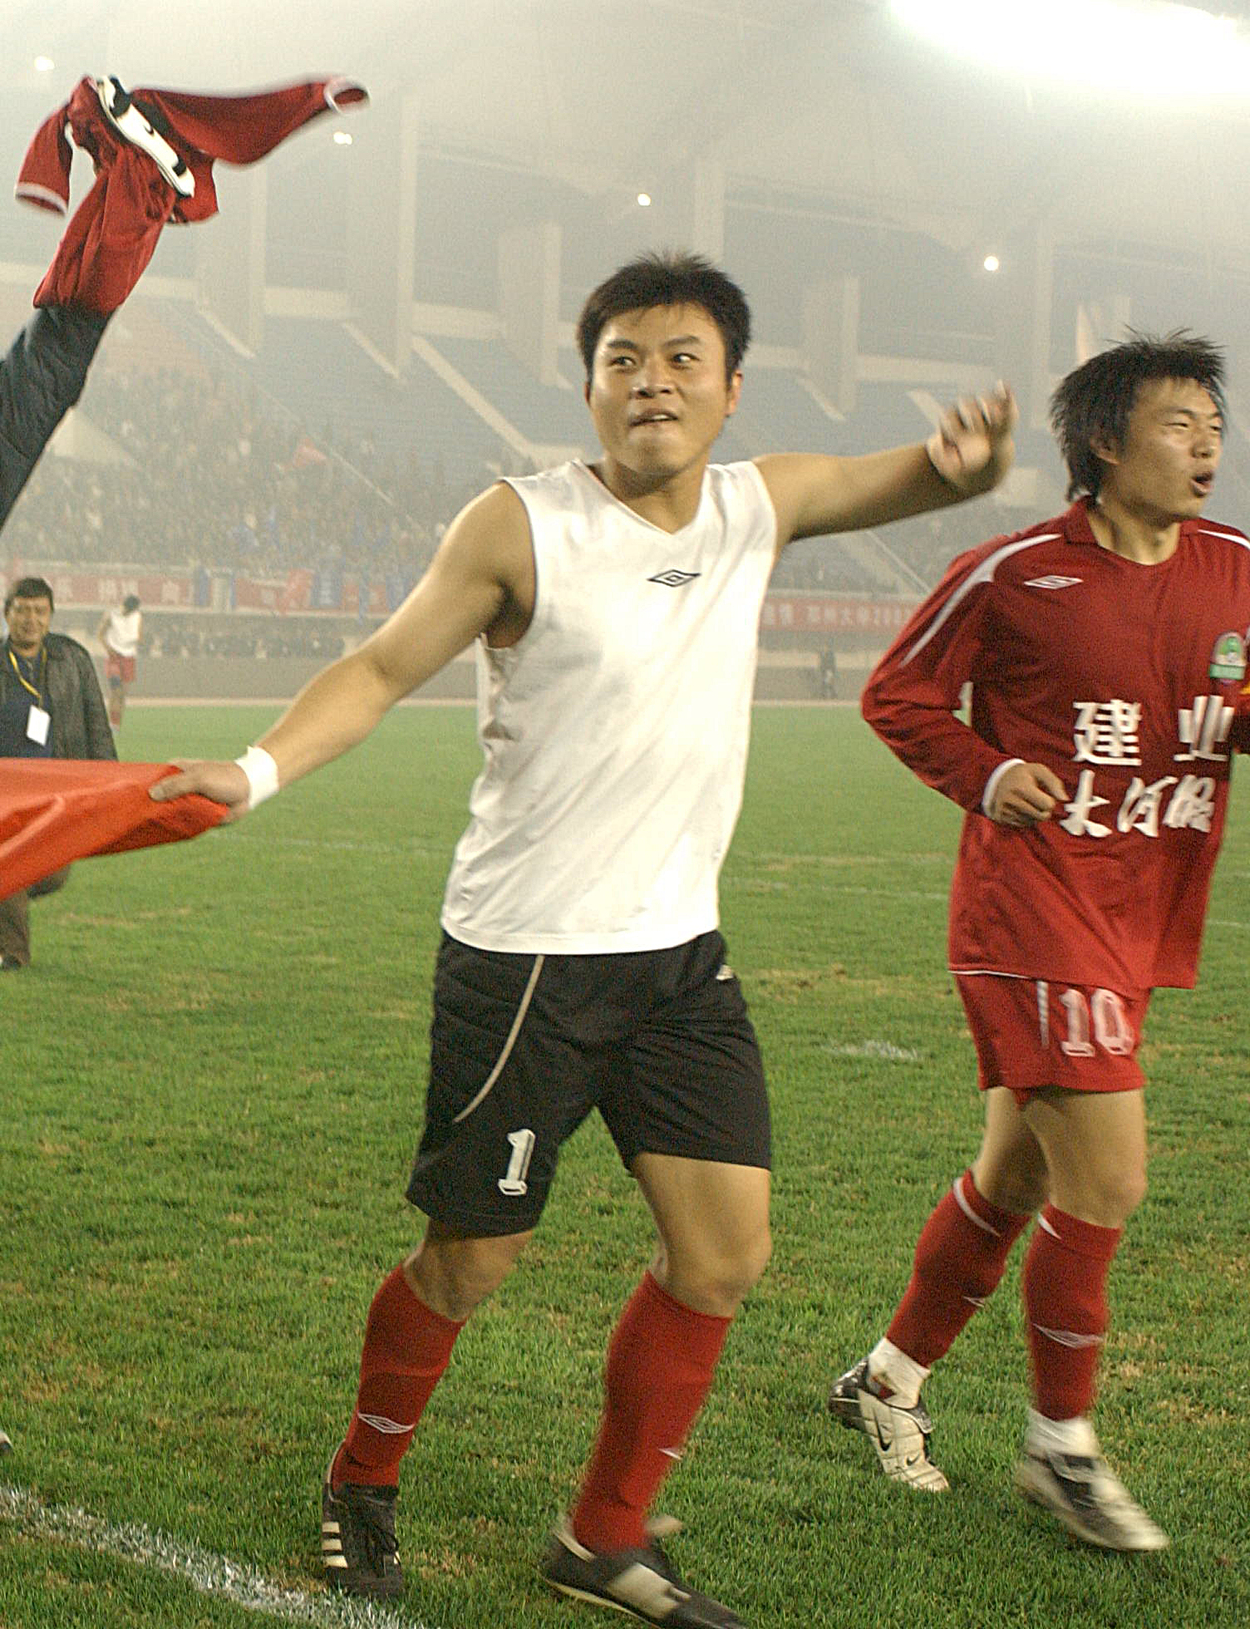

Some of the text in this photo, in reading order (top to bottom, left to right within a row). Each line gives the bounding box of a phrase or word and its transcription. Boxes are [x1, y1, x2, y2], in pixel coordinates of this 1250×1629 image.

[1072, 695, 1234, 766] 建业
[1061, 988, 1135, 1057] 10
[497, 1128, 525, 1195] 1
